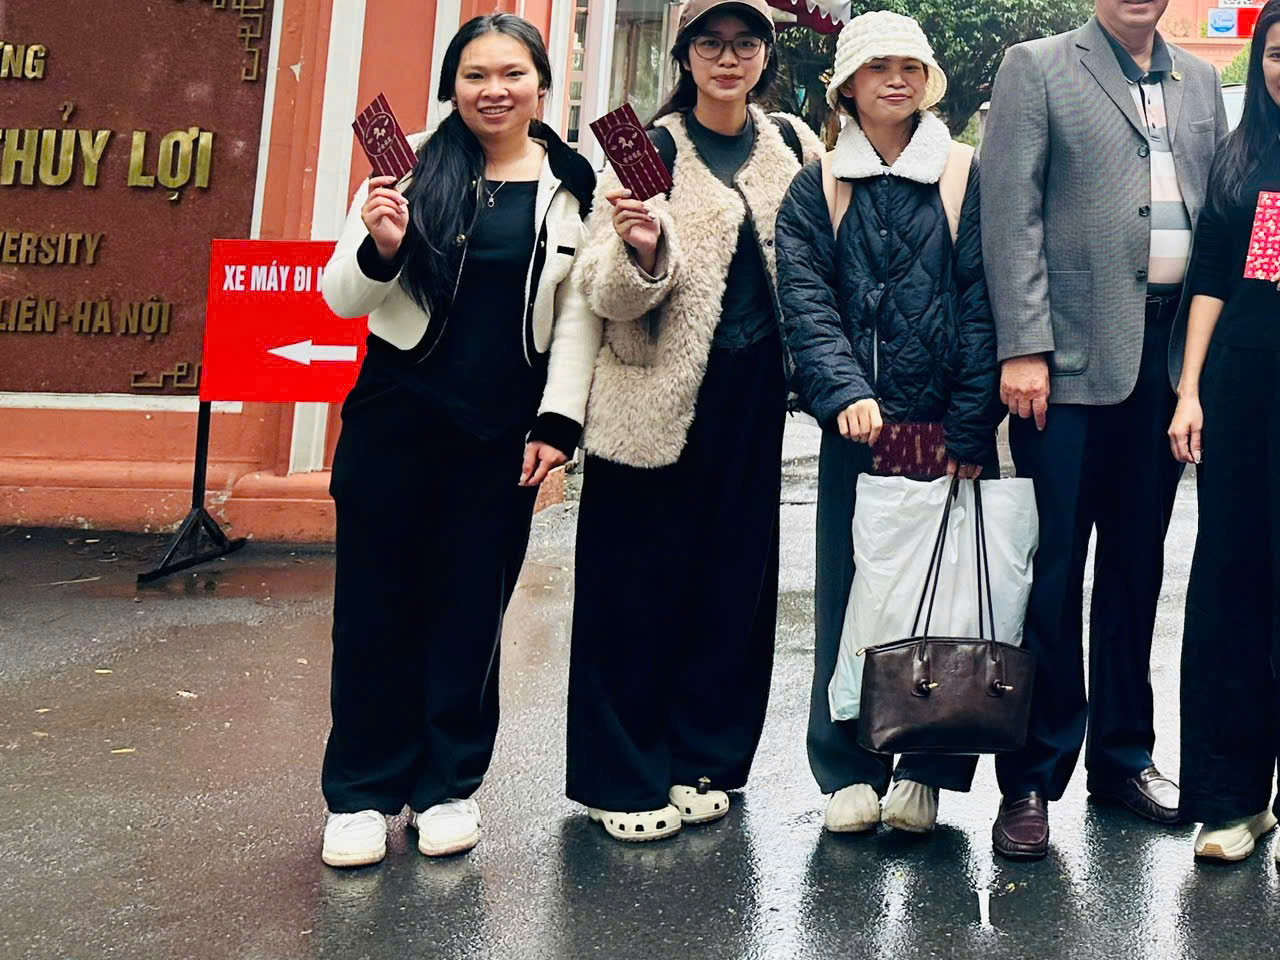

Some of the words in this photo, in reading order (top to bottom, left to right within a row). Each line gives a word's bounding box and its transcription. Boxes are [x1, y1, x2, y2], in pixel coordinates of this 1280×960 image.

[0, 41, 46, 80] NG
[0, 100, 112, 187] HỦY
[127, 126, 214, 202] LỢI
[223, 264, 247, 291] XE
[250, 259, 291, 292] MÁY
[293, 266, 313, 292] ĐI
[119, 294, 171, 341] NỘI
